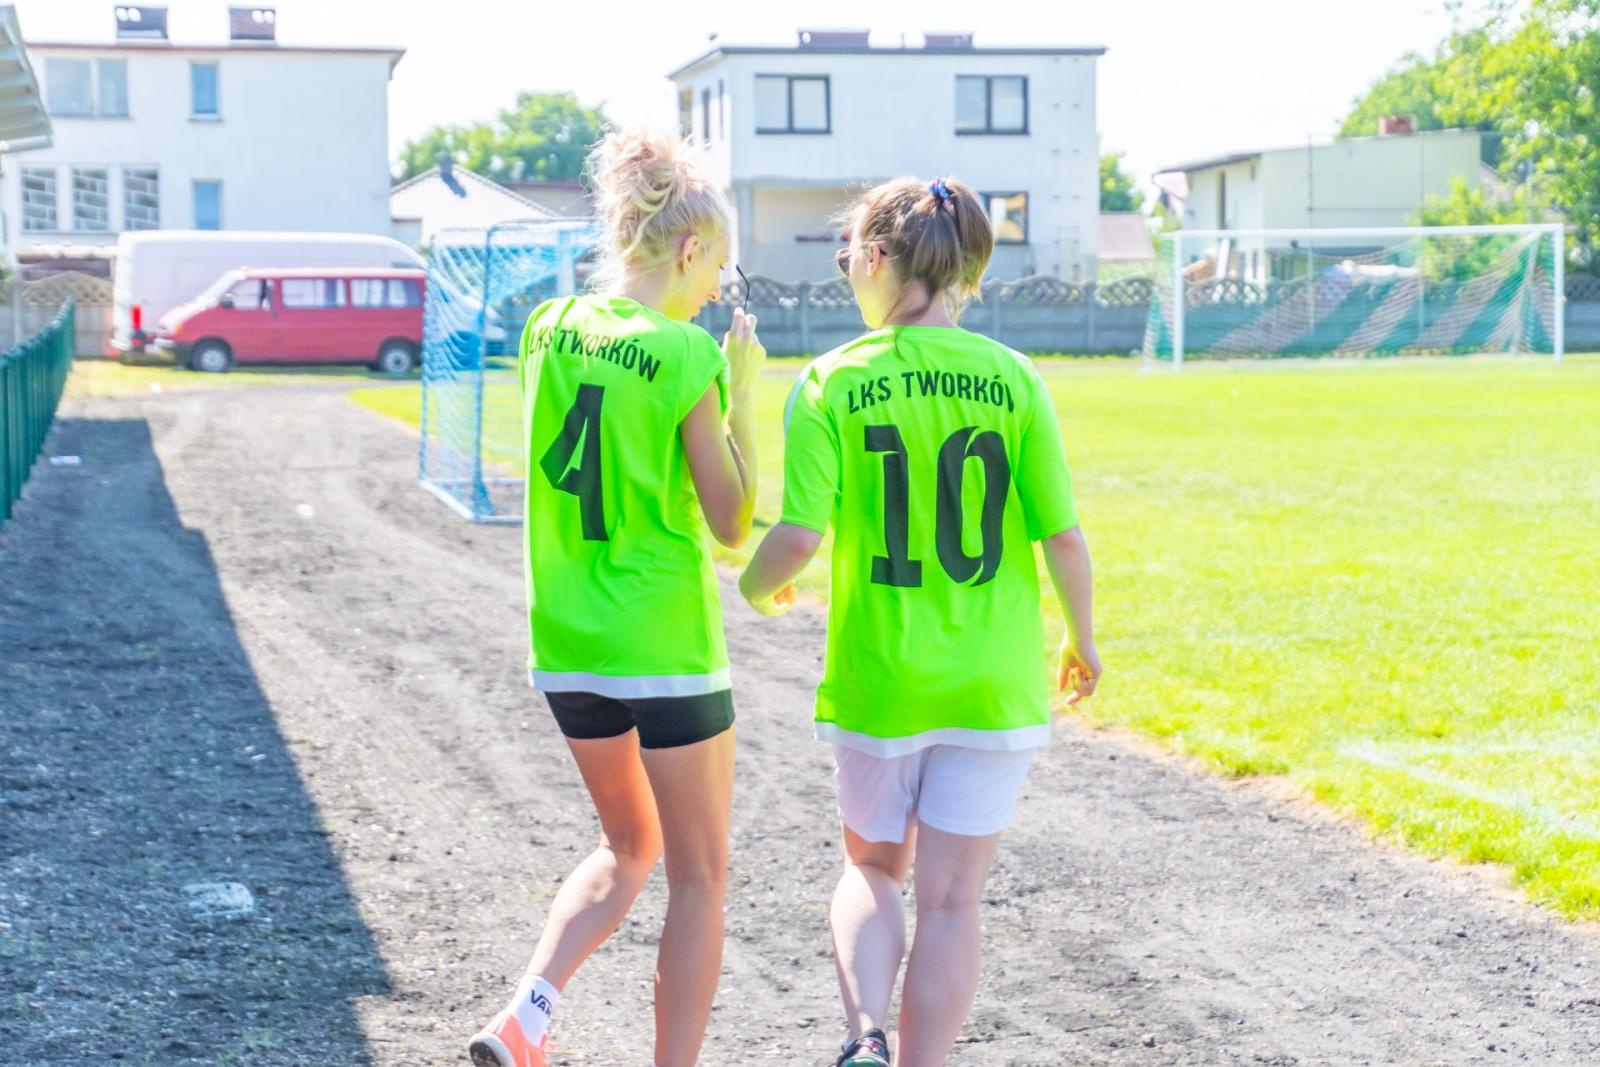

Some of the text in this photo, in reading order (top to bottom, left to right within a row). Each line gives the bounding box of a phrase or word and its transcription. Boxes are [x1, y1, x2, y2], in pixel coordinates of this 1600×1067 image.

[529, 326, 662, 383] LKS TWORKÓW
[848, 375, 892, 415] LKS
[539, 382, 609, 542] 4
[864, 424, 1011, 588] 10
[530, 989, 553, 1017] VAN
